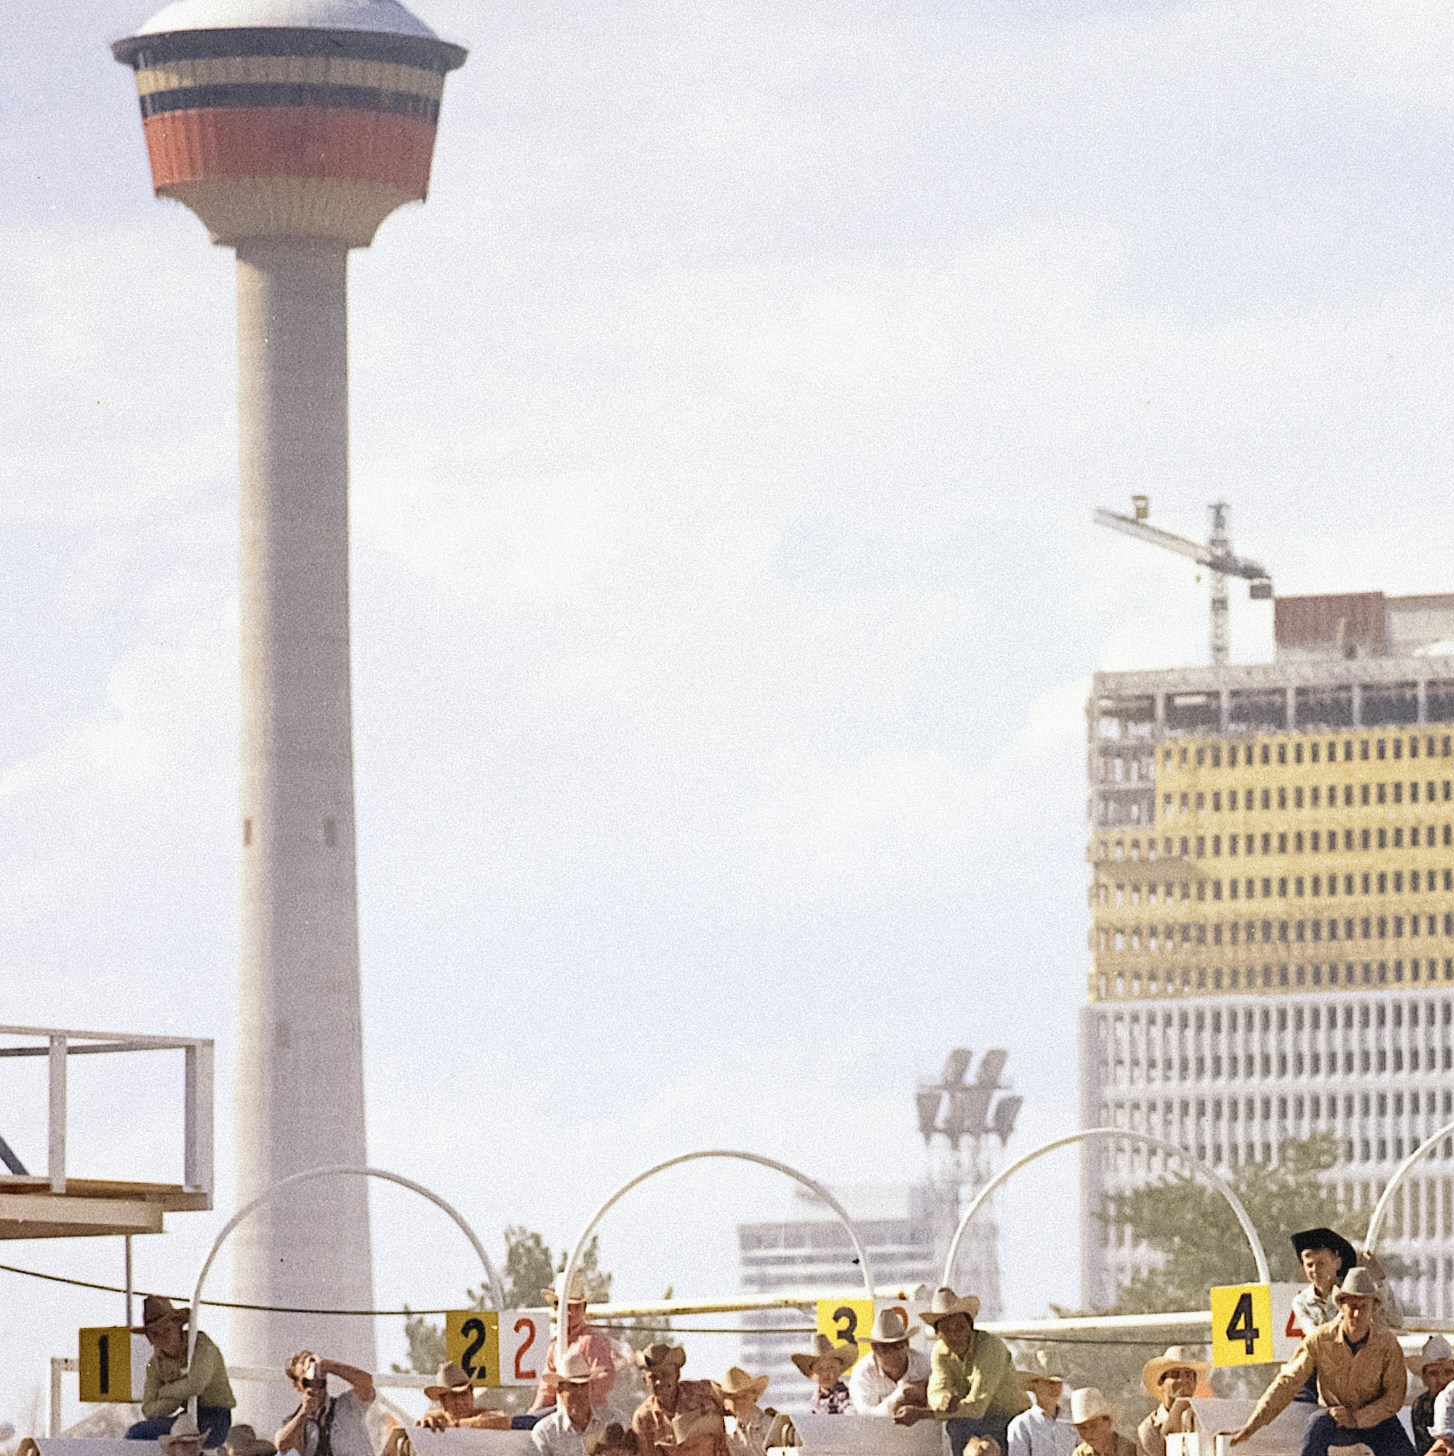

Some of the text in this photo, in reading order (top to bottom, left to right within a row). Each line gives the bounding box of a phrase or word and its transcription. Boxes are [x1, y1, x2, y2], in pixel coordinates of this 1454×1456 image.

[461, 1318, 486, 1379] 2
[513, 1317, 537, 1379] 2
[1226, 1292, 1260, 1355] 4
[98, 1334, 110, 1395] 1
